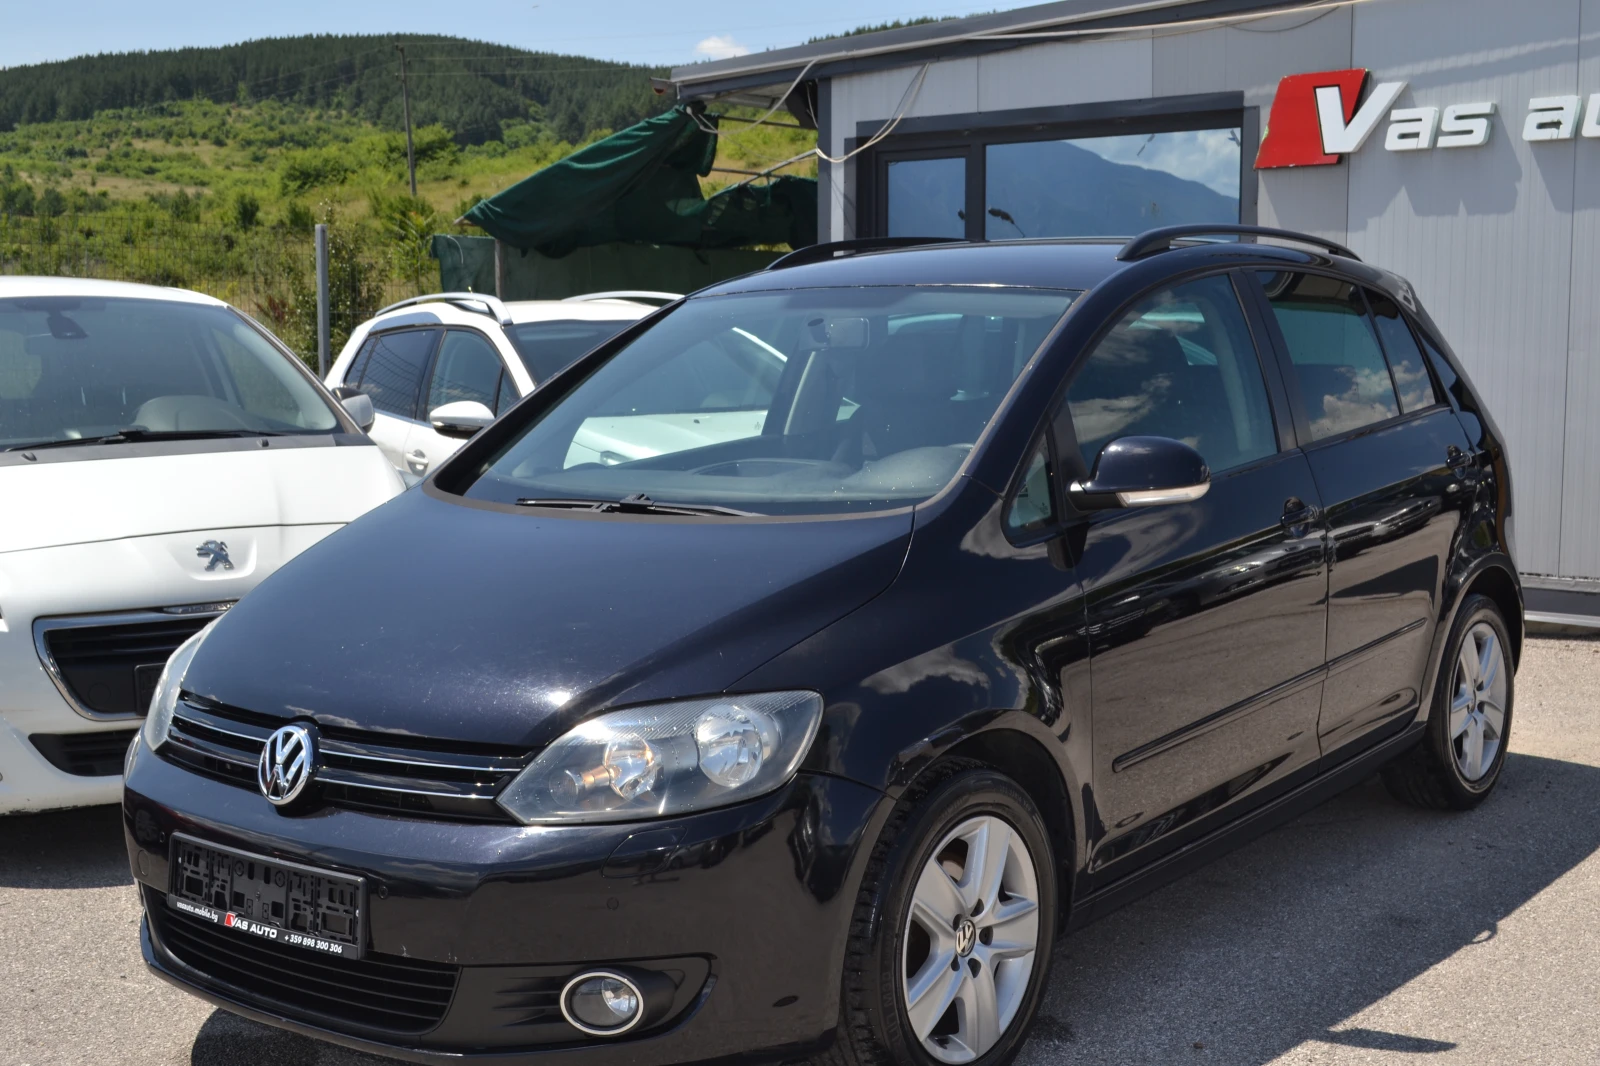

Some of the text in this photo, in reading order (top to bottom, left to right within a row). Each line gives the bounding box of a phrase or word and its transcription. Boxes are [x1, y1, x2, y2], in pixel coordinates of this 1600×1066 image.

[1315, 81, 1497, 153] Vas
[259, 727, 312, 802] VW
[230, 915, 278, 939] VAS AUTO
[289, 934, 302, 944] 359
[302, 937, 315, 947] 898
[315, 940, 329, 951] 300
[329, 943, 343, 954] 306
